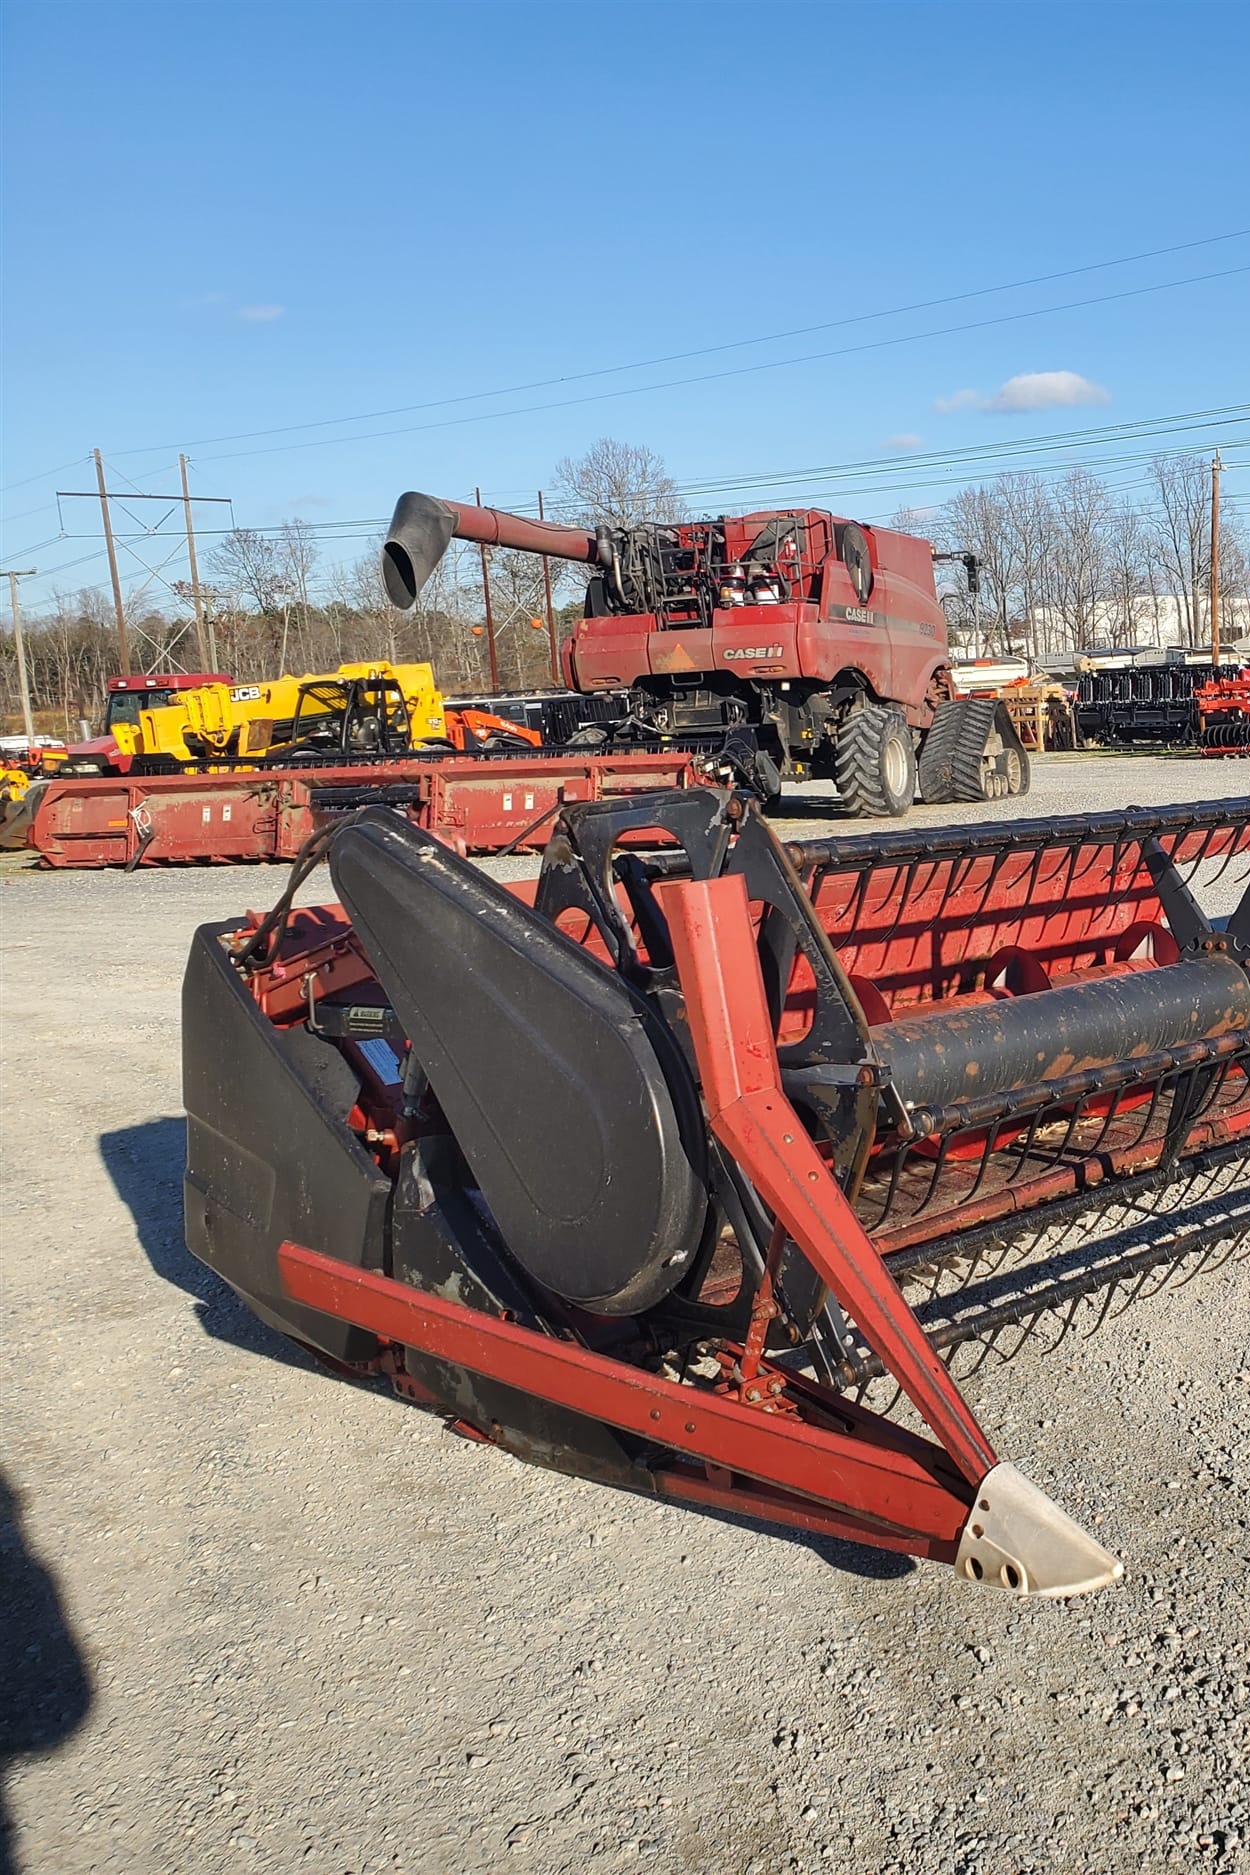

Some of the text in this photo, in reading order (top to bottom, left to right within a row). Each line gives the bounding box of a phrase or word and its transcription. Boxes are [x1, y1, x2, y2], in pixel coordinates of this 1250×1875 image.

[845, 606, 867, 623] CASE
[723, 646, 767, 660] CASE
[230, 687, 260, 701] JCB
